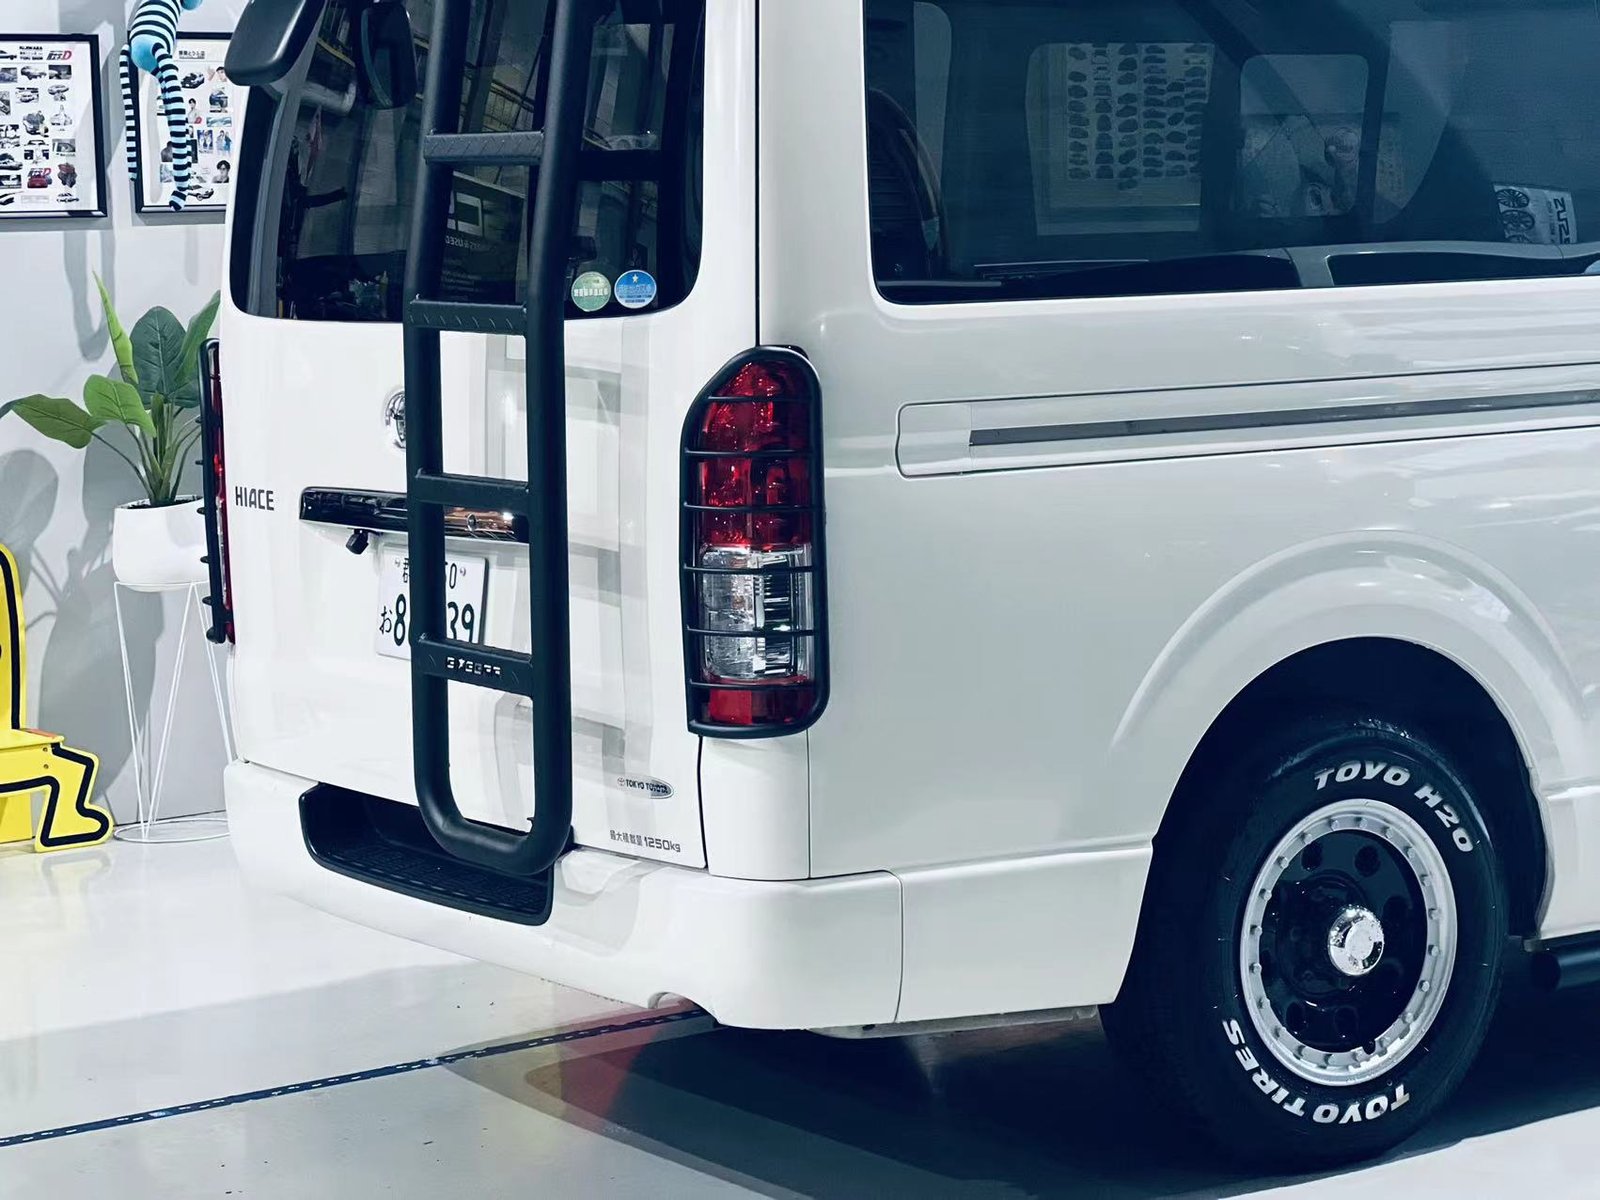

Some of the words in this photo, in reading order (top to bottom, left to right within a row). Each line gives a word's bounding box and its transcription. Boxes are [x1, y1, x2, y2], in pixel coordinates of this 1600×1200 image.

[235, 486, 275, 511] HIACE
[379, 605, 393, 635] お
[625, 778, 645, 790] TOKYO
[1313, 760, 1411, 791] TOYO
[644, 836, 681, 853] 1250kg
[1221, 1018, 1306, 1117] TIRES
[1312, 1084, 1411, 1125] TOYO
